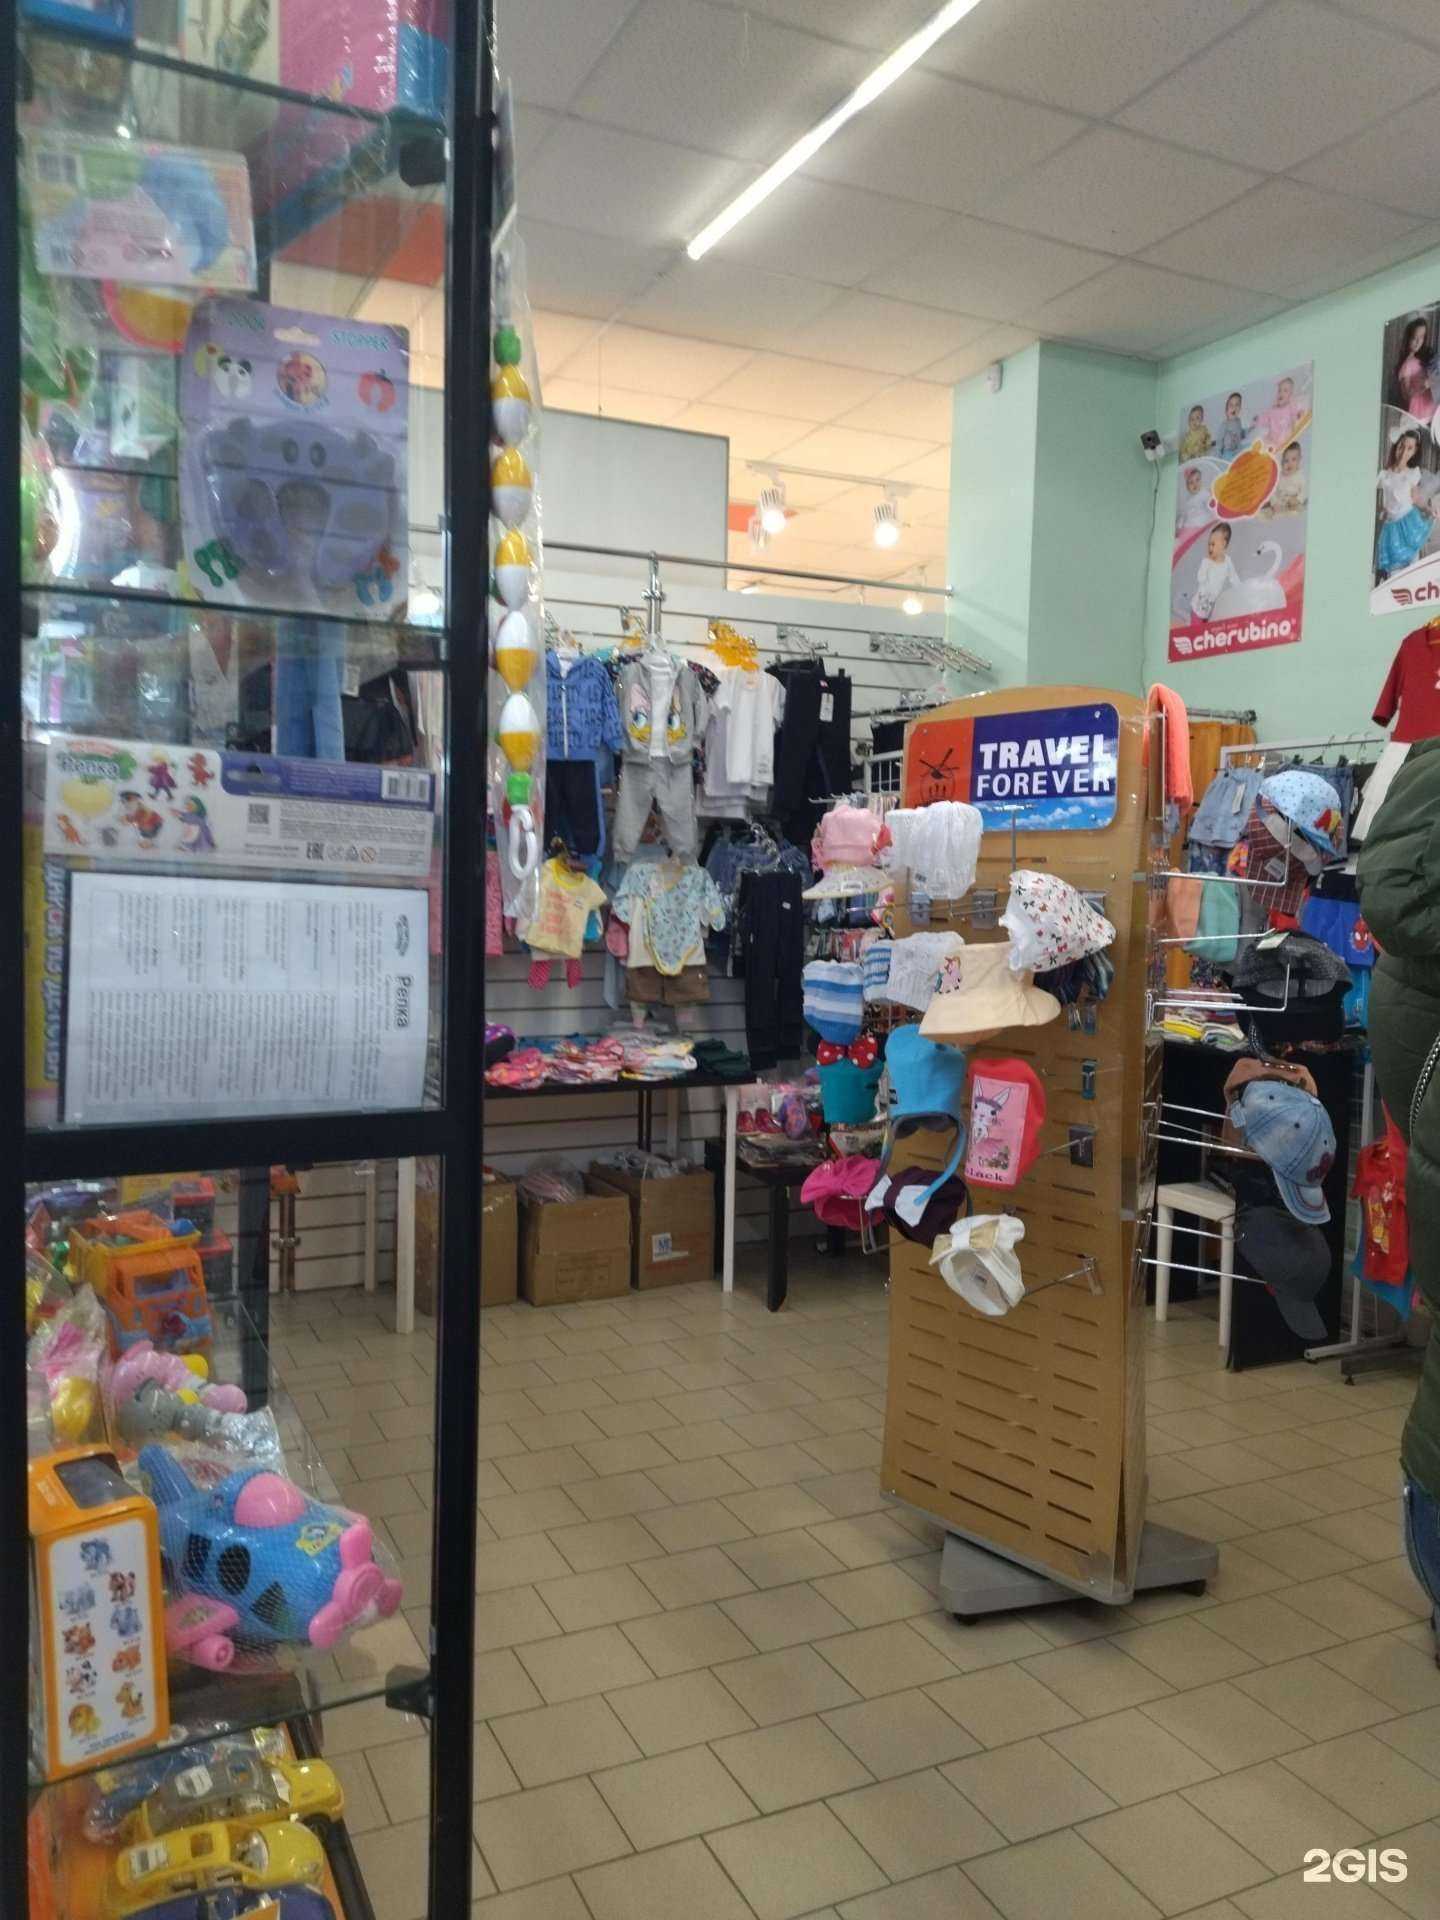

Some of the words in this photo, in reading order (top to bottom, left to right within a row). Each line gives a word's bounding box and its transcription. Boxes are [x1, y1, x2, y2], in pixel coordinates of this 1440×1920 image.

[1192, 618, 1292, 652] cherubino
[979, 733, 1112, 770] TRAVEL
[976, 766, 1111, 798] FOREVER
[396, 974, 413, 1028] Репка
